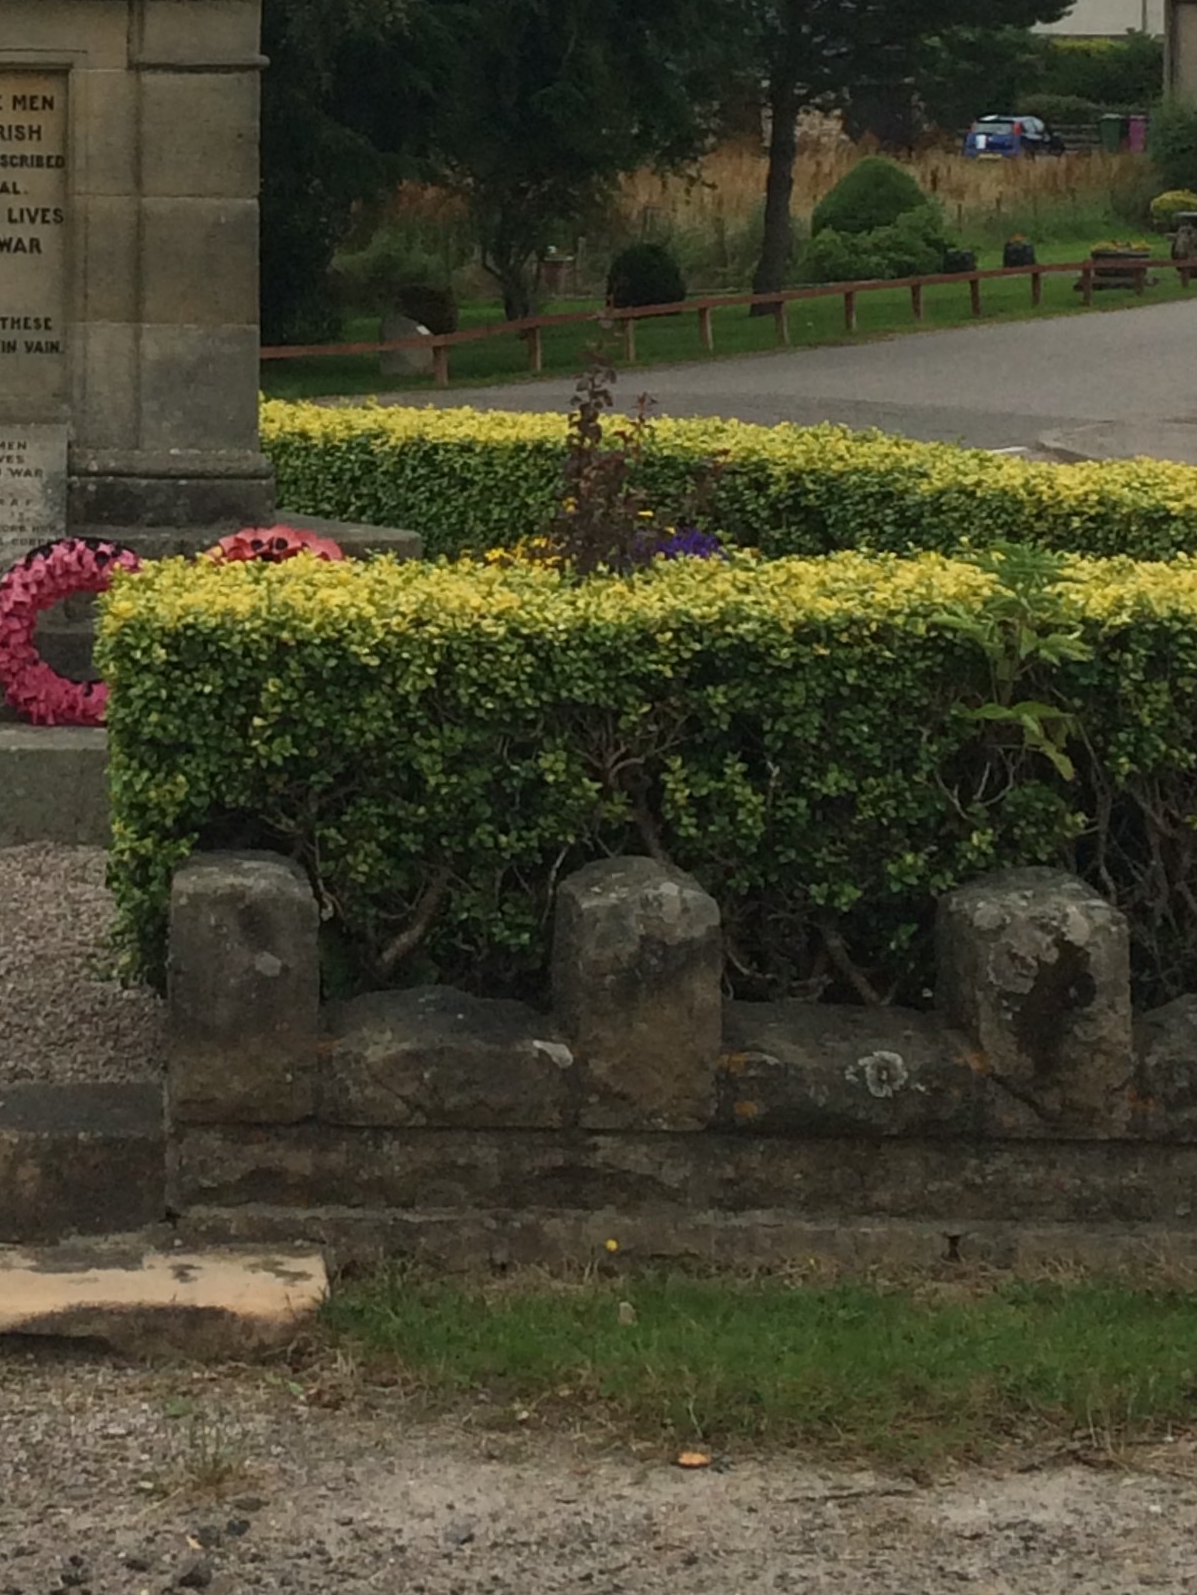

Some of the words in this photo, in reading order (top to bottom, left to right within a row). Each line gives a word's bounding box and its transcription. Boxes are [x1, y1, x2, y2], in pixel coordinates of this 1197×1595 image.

[12, 95, 55, 112] MEN
[7, 208, 65, 225] LIVES
[0, 317, 53, 331] THESE
[0, 341, 18, 354] IN
[6, 466, 44, 478] WAR
